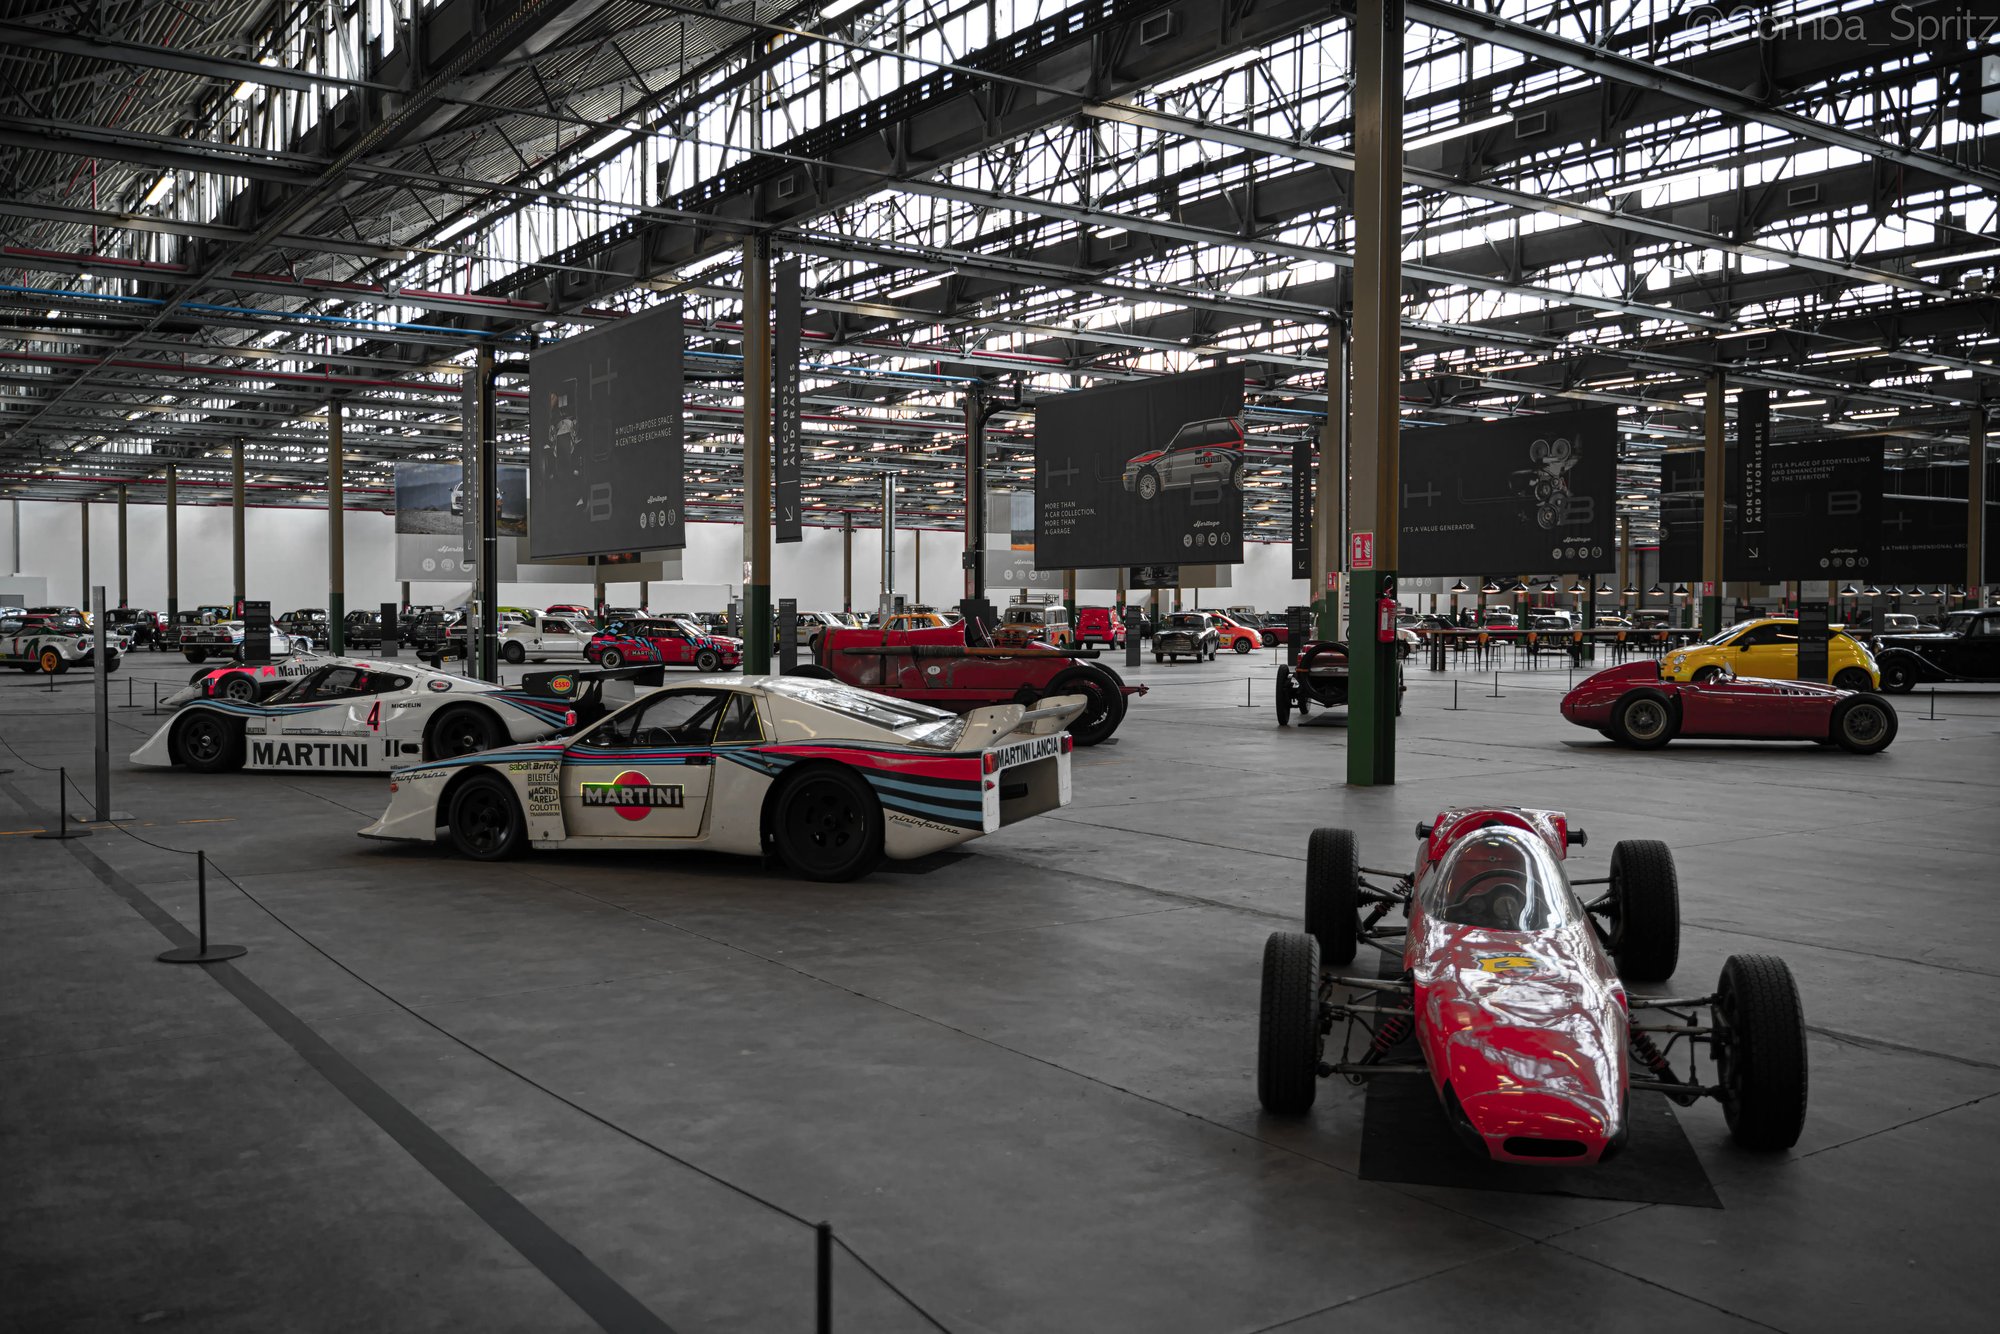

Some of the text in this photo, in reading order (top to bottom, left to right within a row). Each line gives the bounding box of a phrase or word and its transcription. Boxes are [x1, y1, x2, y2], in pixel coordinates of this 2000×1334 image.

[619, 418, 657, 434] MULTI-PURPOSE
[657, 415, 673, 426] SPACE
[619, 436, 637, 447] CENTRE
[645, 427, 672, 441] EXCHANGE
[1822, 456, 1871, 466] STORYTELLING
[1786, 466, 1836, 475] ENHANCEMENT
[1061, 508, 1096, 517] COLLECTION,
[1193, 520, 1220, 528] Heritage
[1439, 523, 1476, 532] GENERATOR.
[553, 680, 570, 688] Esso
[366, 701, 381, 731] 4
[253, 742, 369, 767] MARTINI
[997, 737, 1059, 768] MARTINI LANCIA
[509, 761, 560, 773] sabelt Britax
[527, 773, 559, 782] BILSTEIN
[585, 787, 682, 805] MARTINI
[529, 804, 560, 812] COLOTTI
[888, 814, 961, 835] pininfarina
